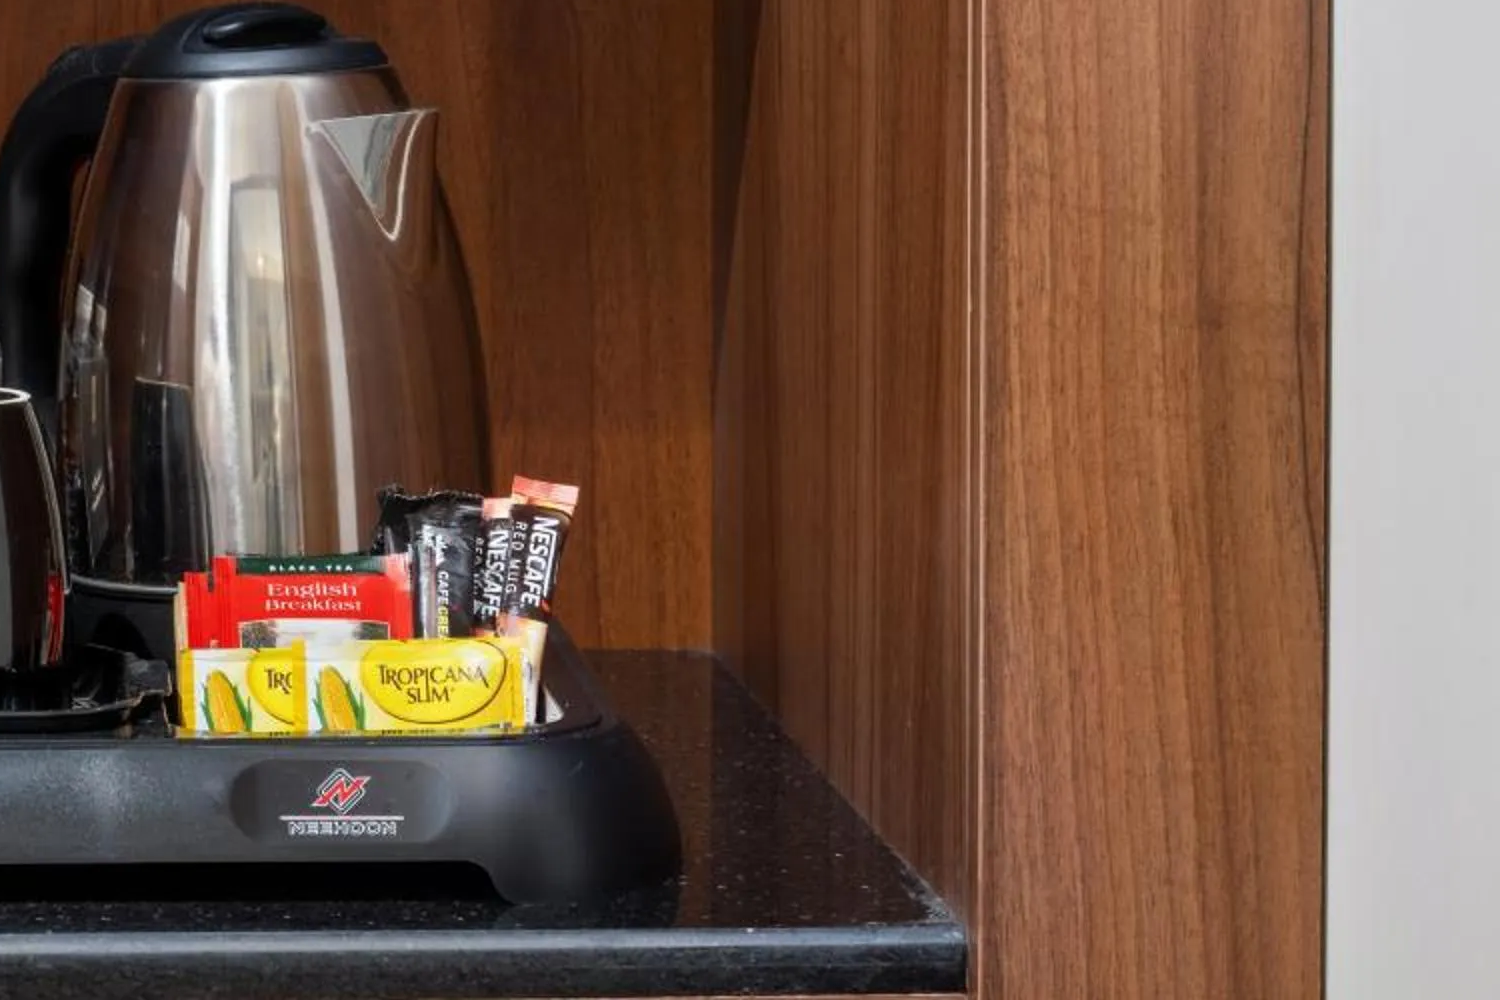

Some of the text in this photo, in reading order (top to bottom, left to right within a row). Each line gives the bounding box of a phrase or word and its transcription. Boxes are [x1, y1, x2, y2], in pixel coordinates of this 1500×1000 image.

[505, 521, 528, 593] RED MUG
[267, 582, 357, 598] English
[265, 600, 361, 611] Breakfast
[378, 664, 489, 691] TROPICANA
[407, 686, 450, 704] SLIM
